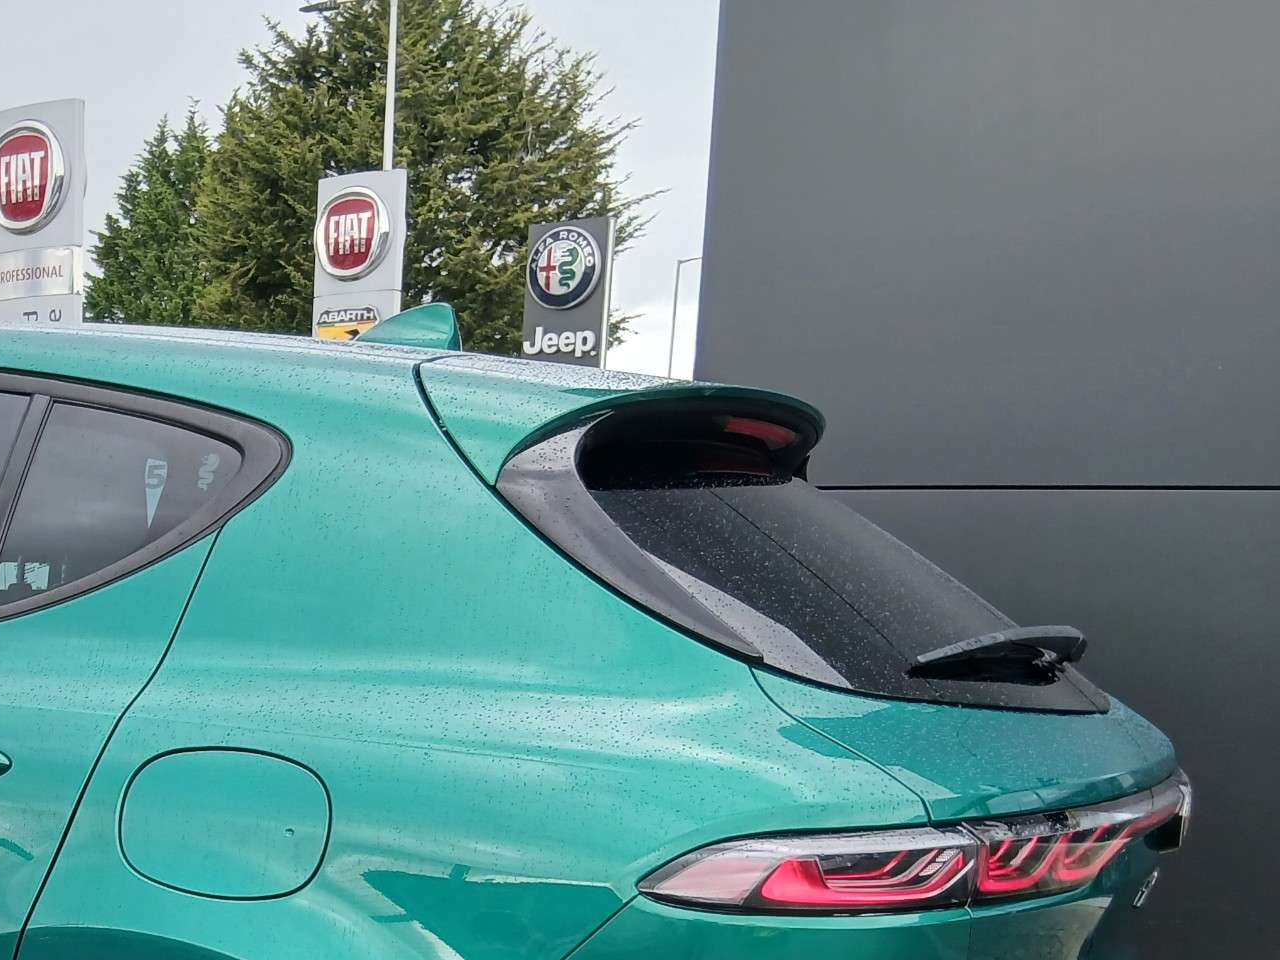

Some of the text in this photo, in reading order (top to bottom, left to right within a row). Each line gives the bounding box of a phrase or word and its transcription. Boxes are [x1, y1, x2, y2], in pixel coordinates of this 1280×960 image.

[0, 151, 45, 205] FIAT
[329, 211, 372, 256] FIAT
[531, 231, 594, 270] ALFA ROMEO
[319, 310, 374, 323] ABARTH
[522, 326, 596, 357] Jeep
